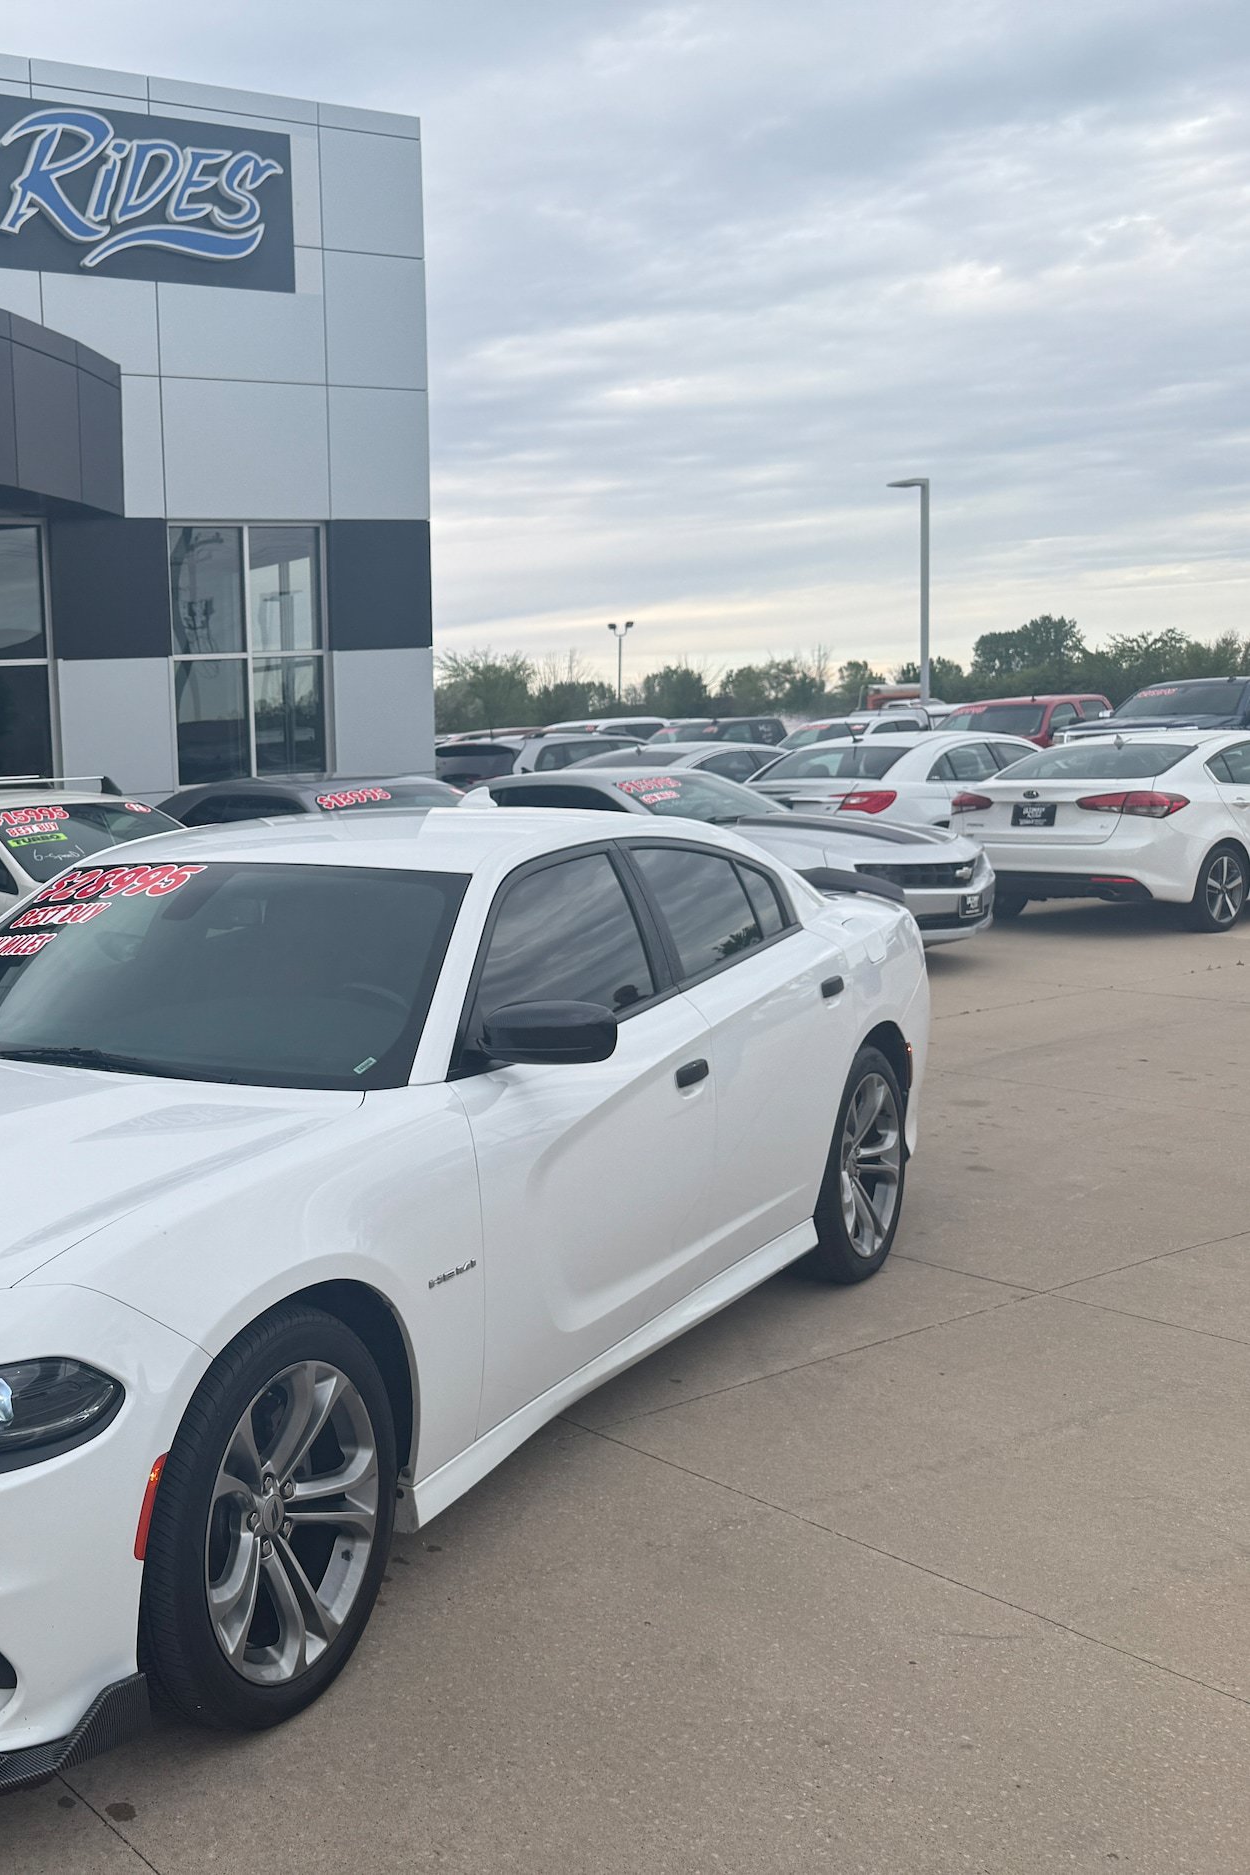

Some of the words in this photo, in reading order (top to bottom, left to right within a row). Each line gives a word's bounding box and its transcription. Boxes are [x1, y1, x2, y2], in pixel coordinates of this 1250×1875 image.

[6, 825, 35, 837] BEST
[37, 821, 59, 833] BUY
[13, 834, 61, 846] TURBO
[33, 864, 208, 904] $28995
[10, 904, 68, 929] BEST
[57, 902, 112, 925] BUY
